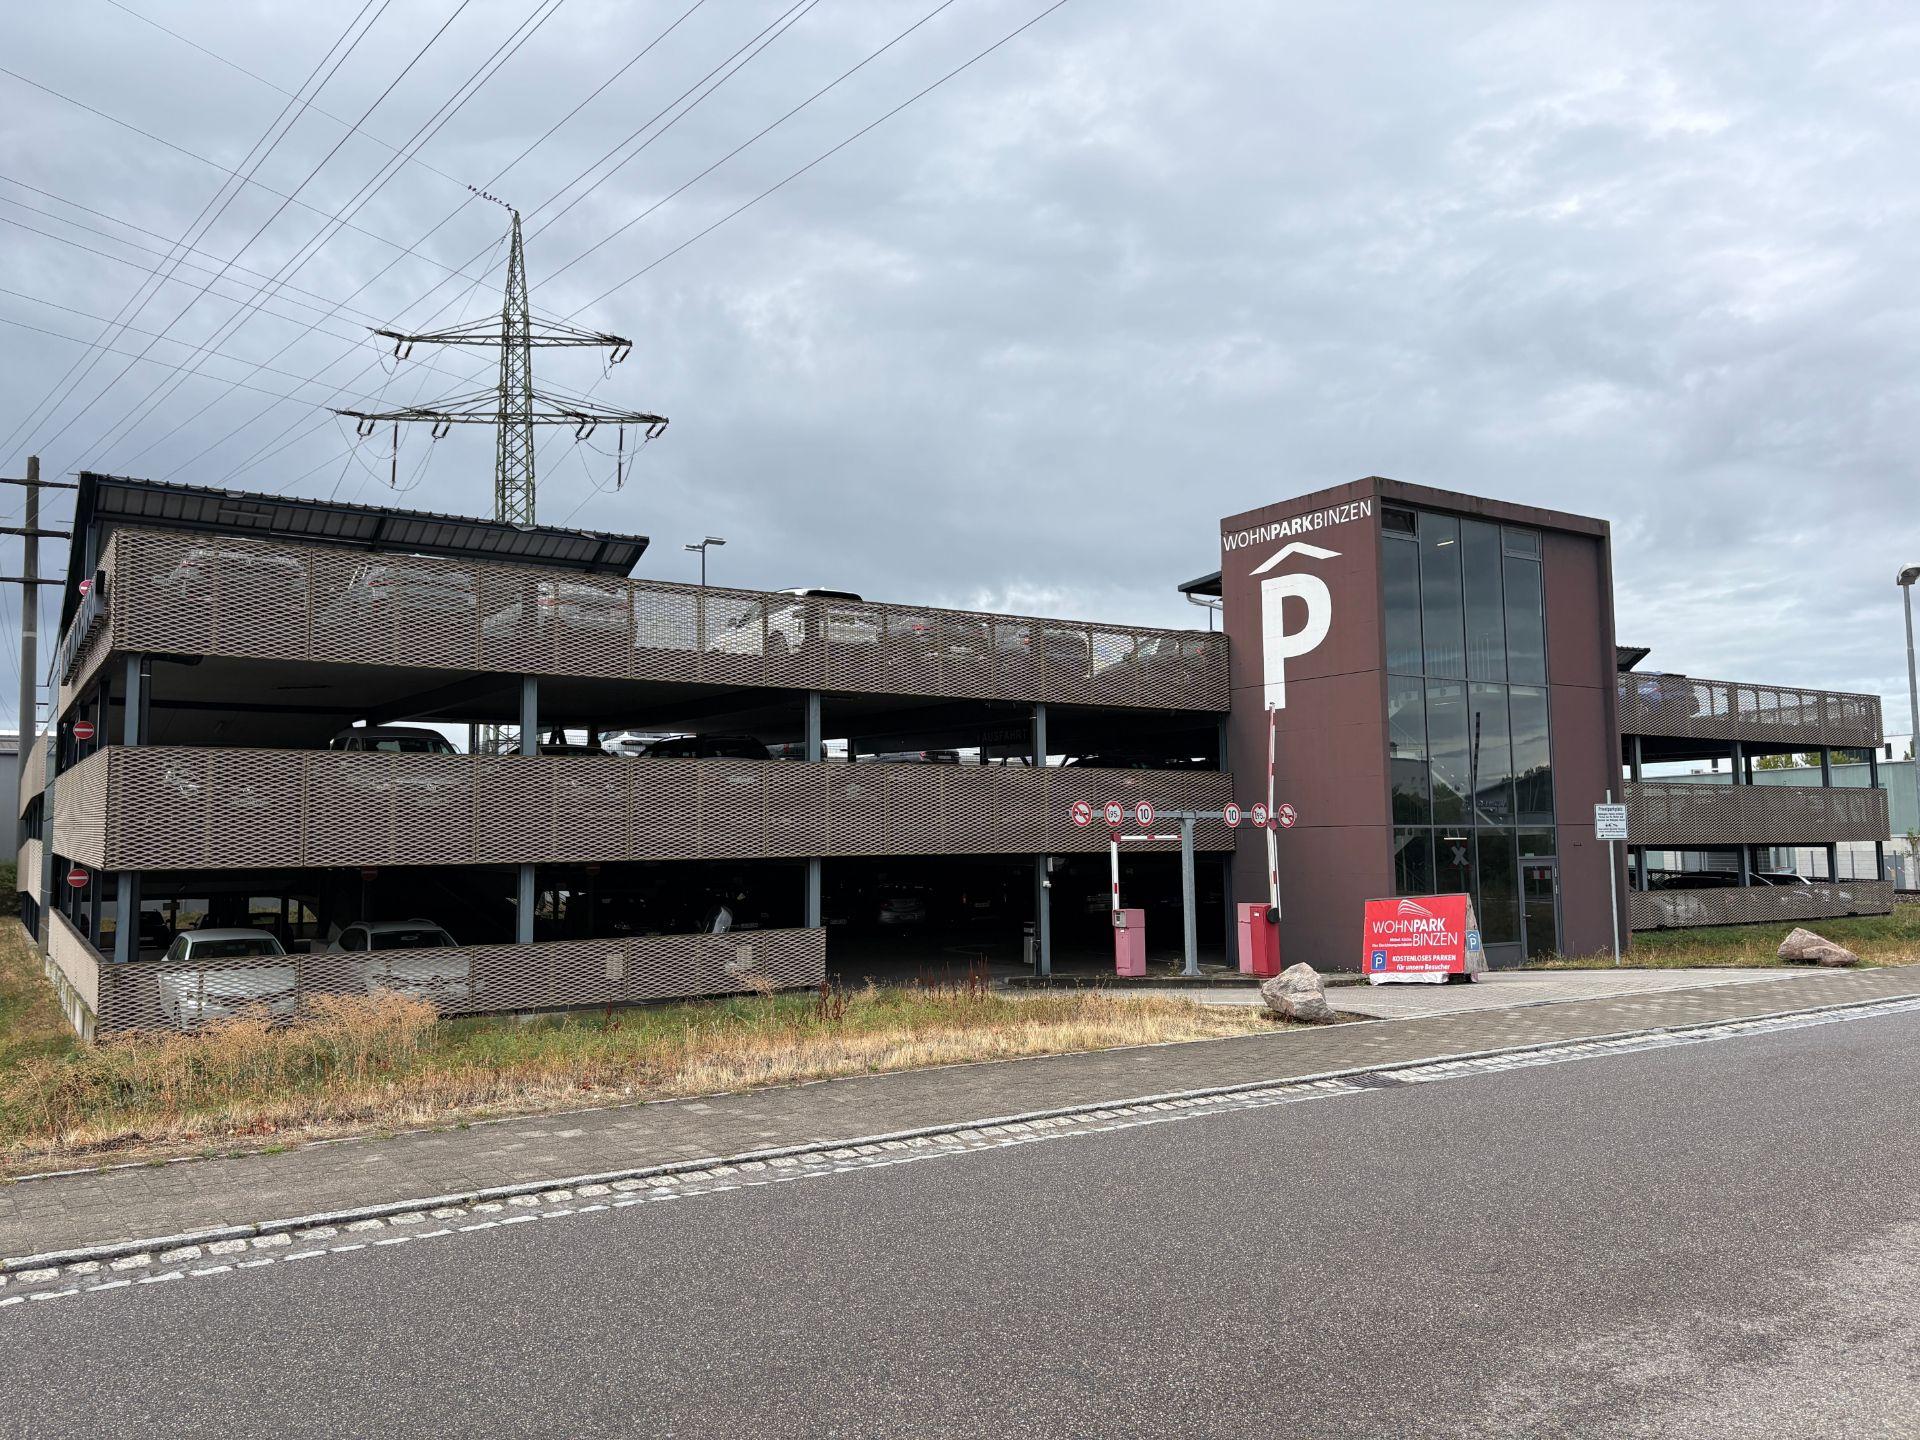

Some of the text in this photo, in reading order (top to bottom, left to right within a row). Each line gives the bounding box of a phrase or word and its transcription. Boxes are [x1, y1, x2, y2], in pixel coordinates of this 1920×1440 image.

[1223, 500, 1371, 551] WOHNPARKBINZEN
[1261, 573, 1331, 710] P
[984, 727, 1028, 742] AUSFAHRT
[1140, 808, 1149, 820] 10
[1228, 810, 1237, 821] 10
[1372, 918, 1446, 933] WOHNPARK
[1413, 932, 1458, 946] BINZEN
[1470, 937, 1477, 949] P
[1375, 957, 1383, 969] P
